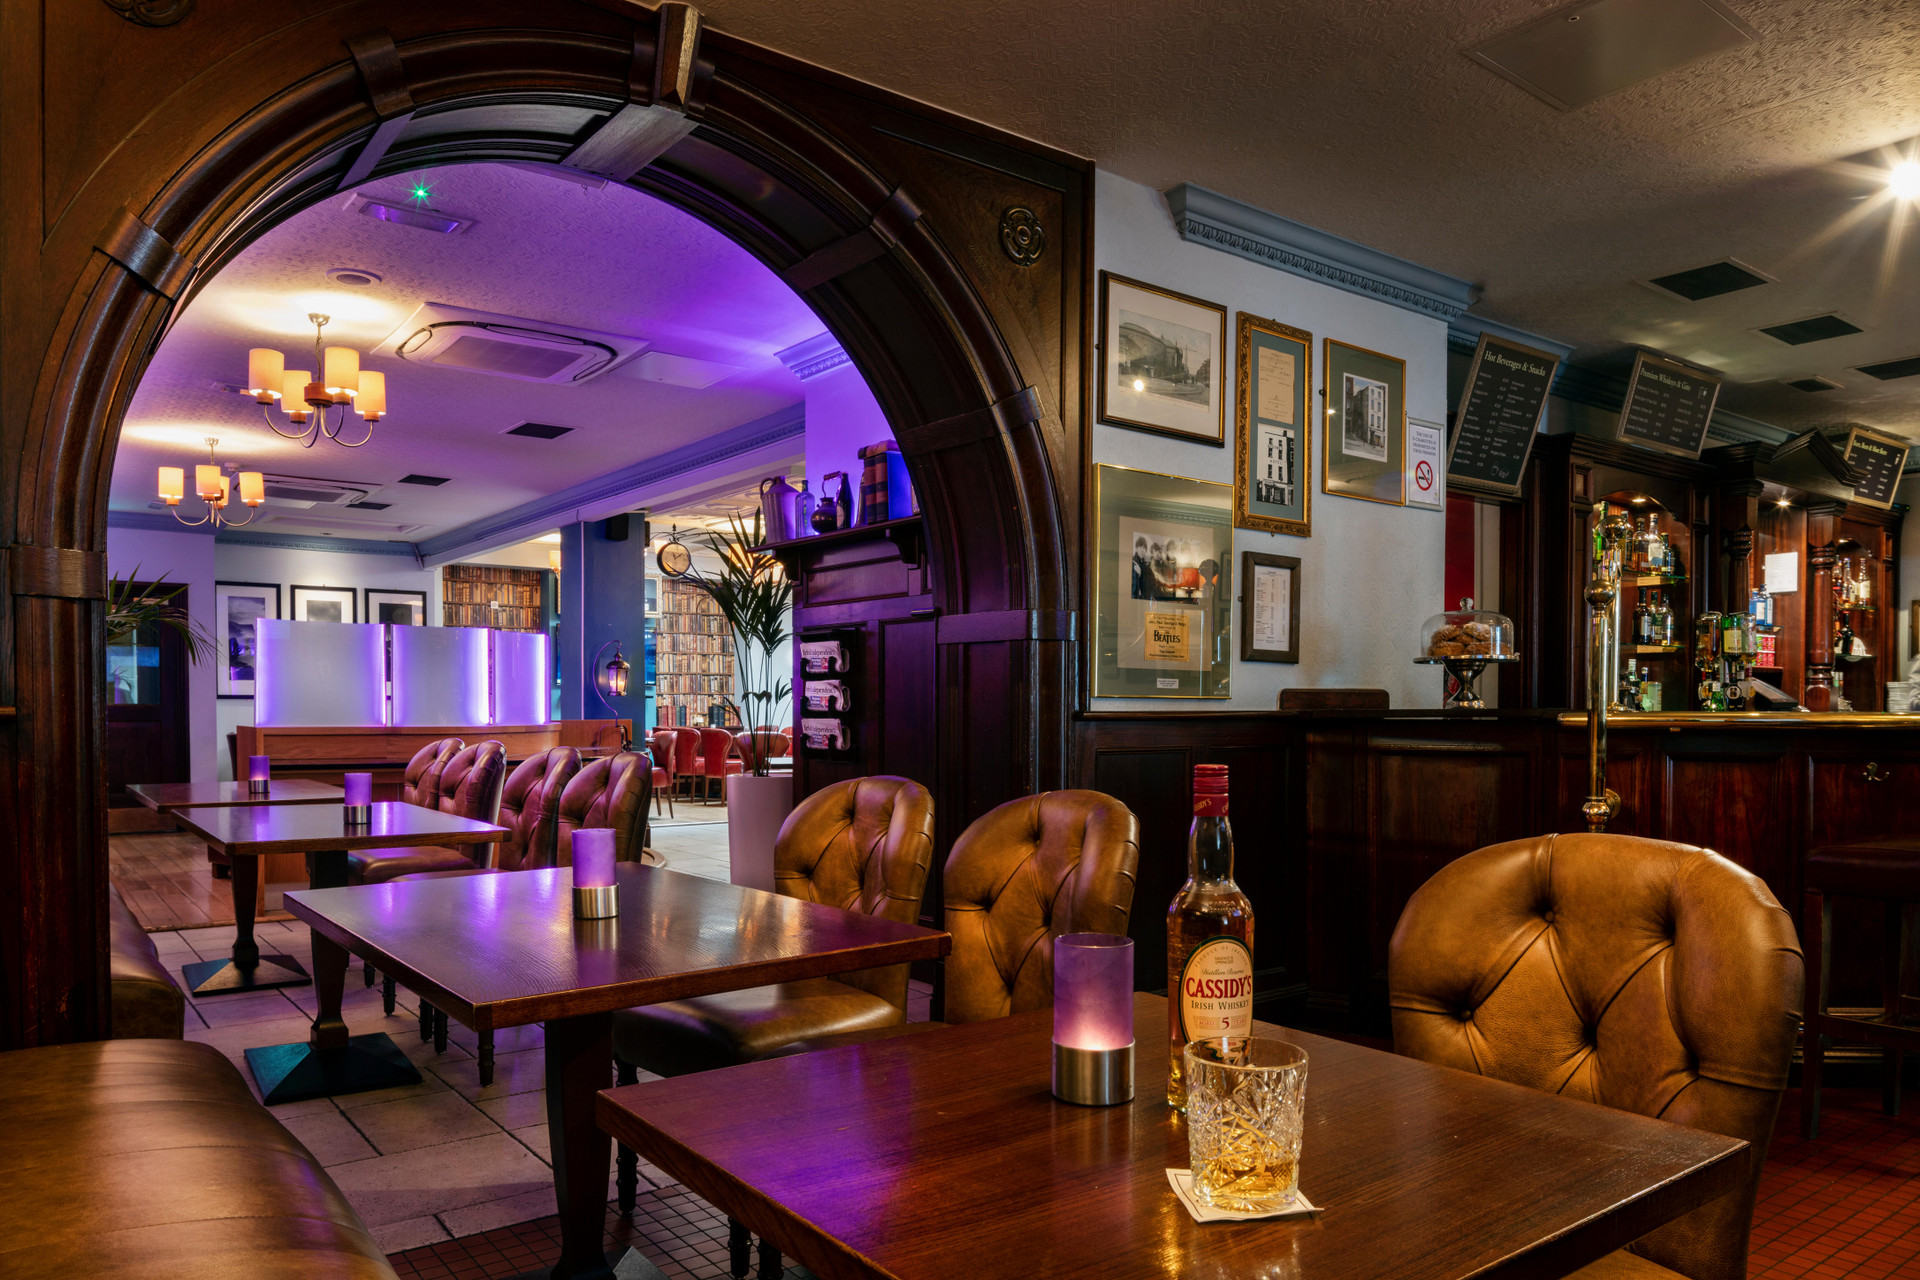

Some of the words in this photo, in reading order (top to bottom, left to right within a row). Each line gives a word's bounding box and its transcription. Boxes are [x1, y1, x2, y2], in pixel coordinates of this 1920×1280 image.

[1484, 350, 1496, 362] Hot
[1496, 354, 1521, 371] Beverages
[1522, 362, 1528, 371] &
[1528, 364, 1546, 377] Snacks
[1154, 630, 1181, 644] BEATLES
[1186, 975, 1251, 999] CASSIDY'S
[1191, 1000, 1214, 1010] IRISH
[1218, 1000, 1249, 1010] WHISKEY
[1222, 1017, 1230, 1030] 5
